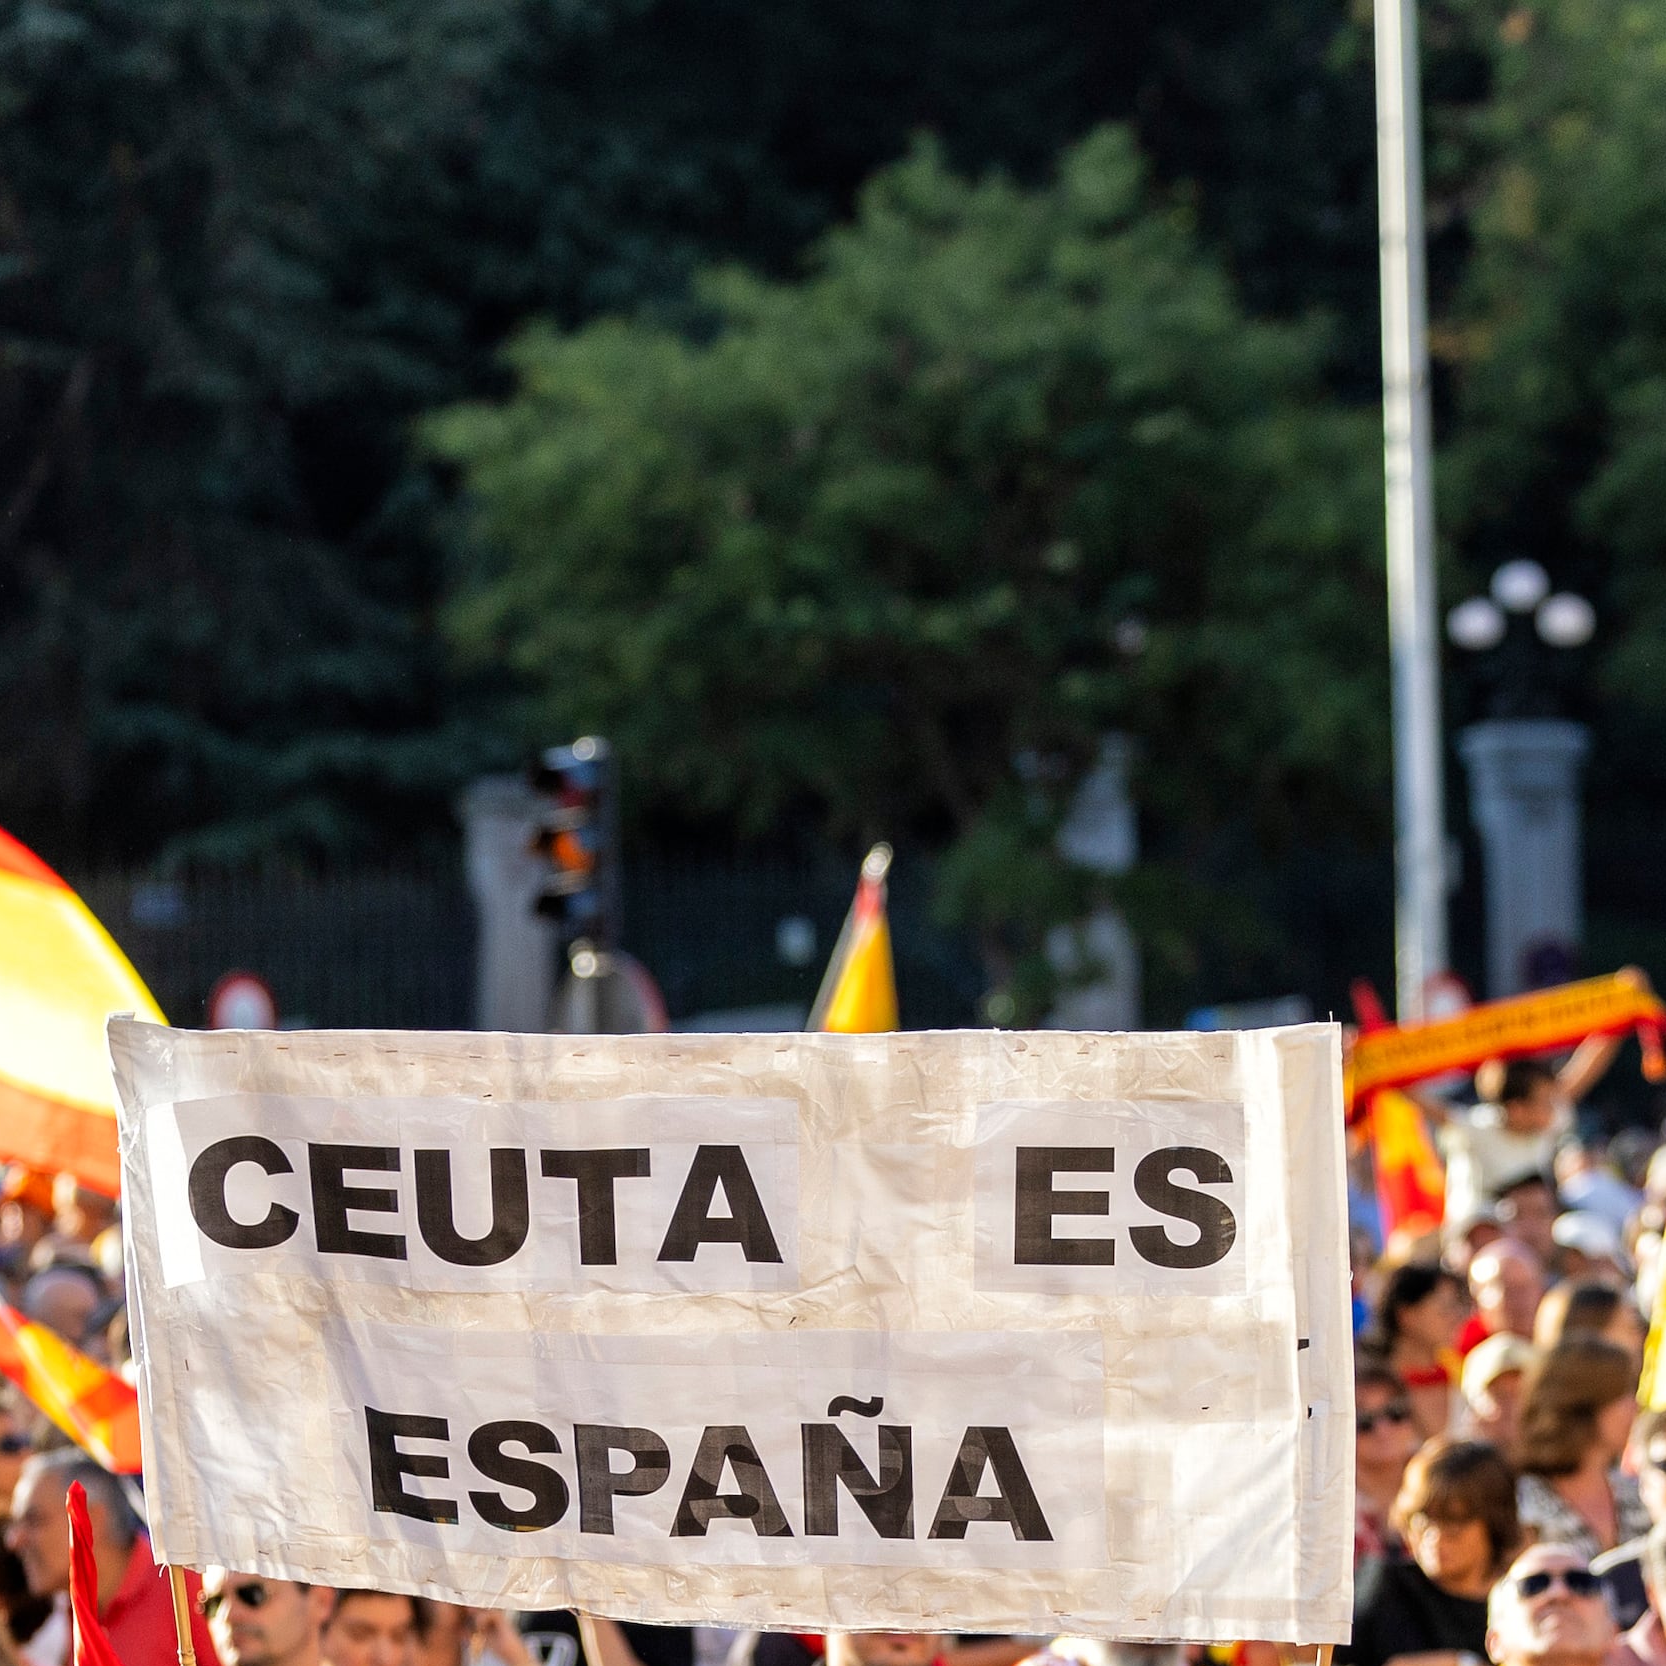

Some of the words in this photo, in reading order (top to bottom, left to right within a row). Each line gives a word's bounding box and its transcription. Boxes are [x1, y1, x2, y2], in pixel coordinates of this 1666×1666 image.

[188, 1135, 784, 1267] CEUTA
[1014, 1146, 1237, 1269] ES
[364, 1395, 1054, 1542] ESPAÑA
